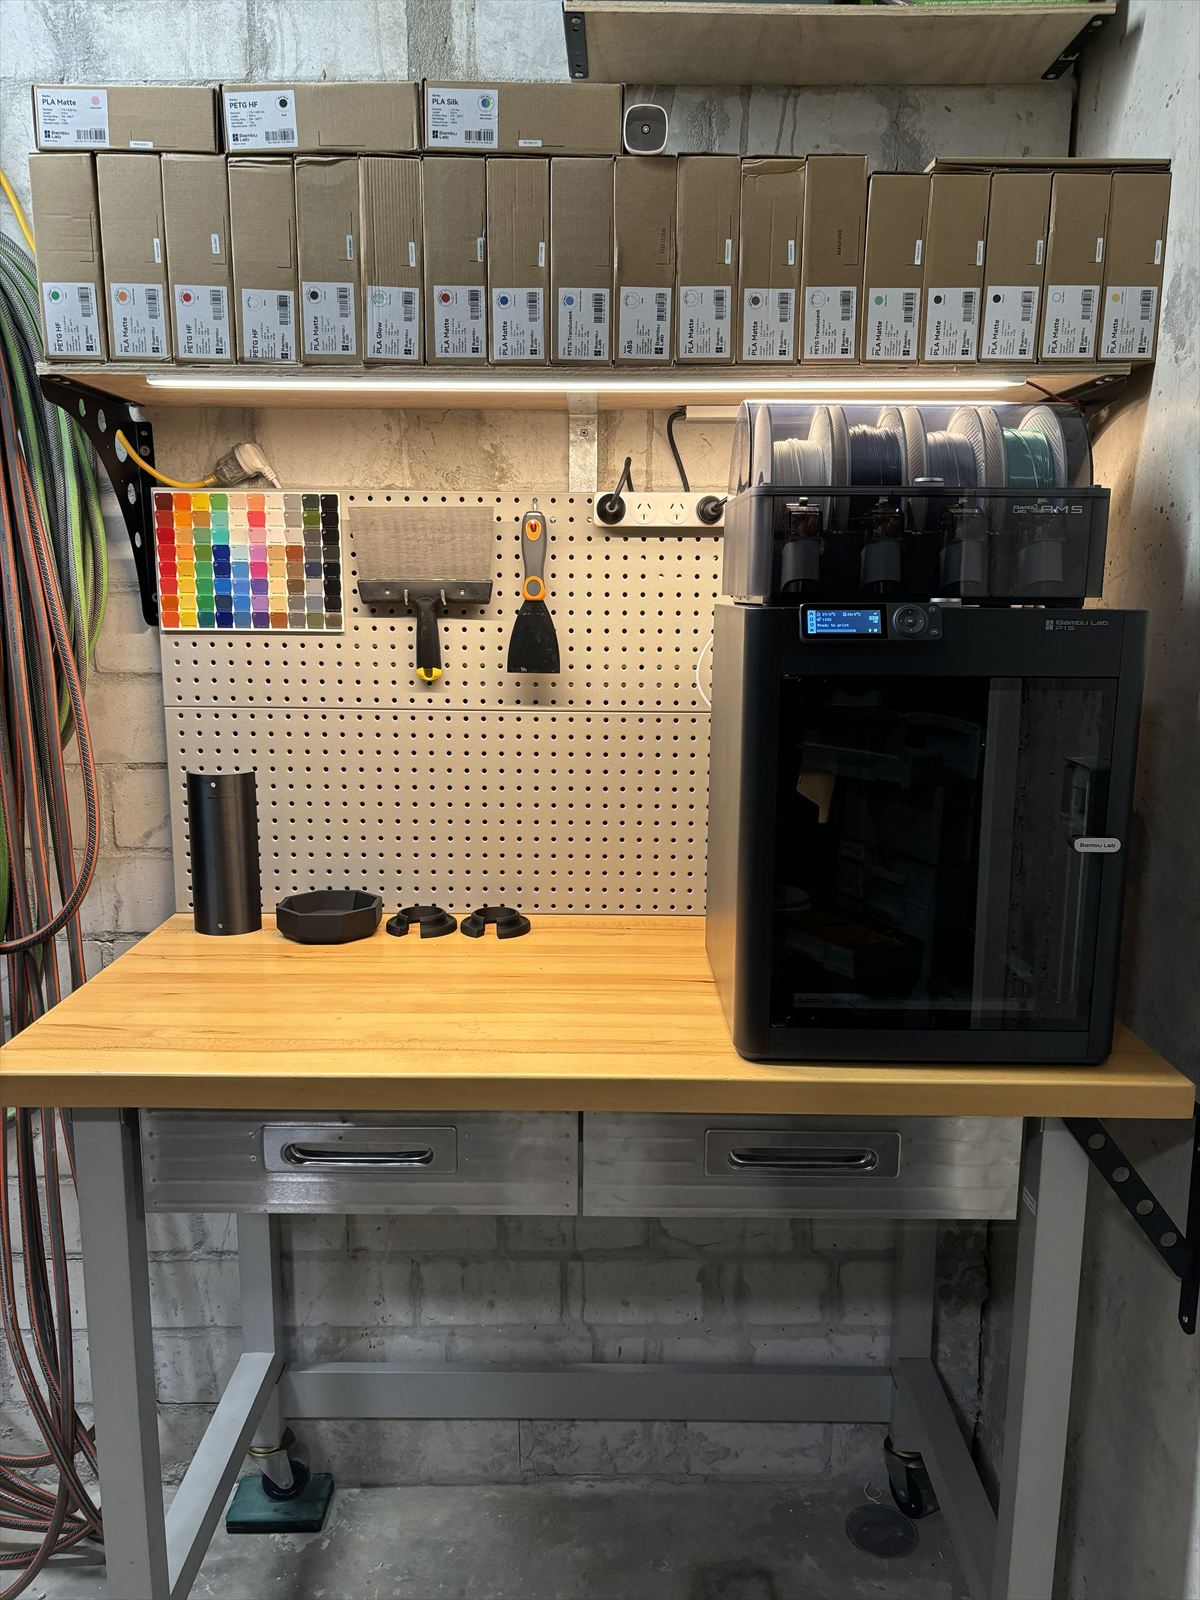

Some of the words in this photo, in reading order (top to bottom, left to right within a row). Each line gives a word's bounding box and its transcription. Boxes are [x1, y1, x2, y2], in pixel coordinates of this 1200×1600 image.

[55, 322, 62, 332] HF
[186, 324, 192, 334] HF
[252, 329, 258, 338] HF
